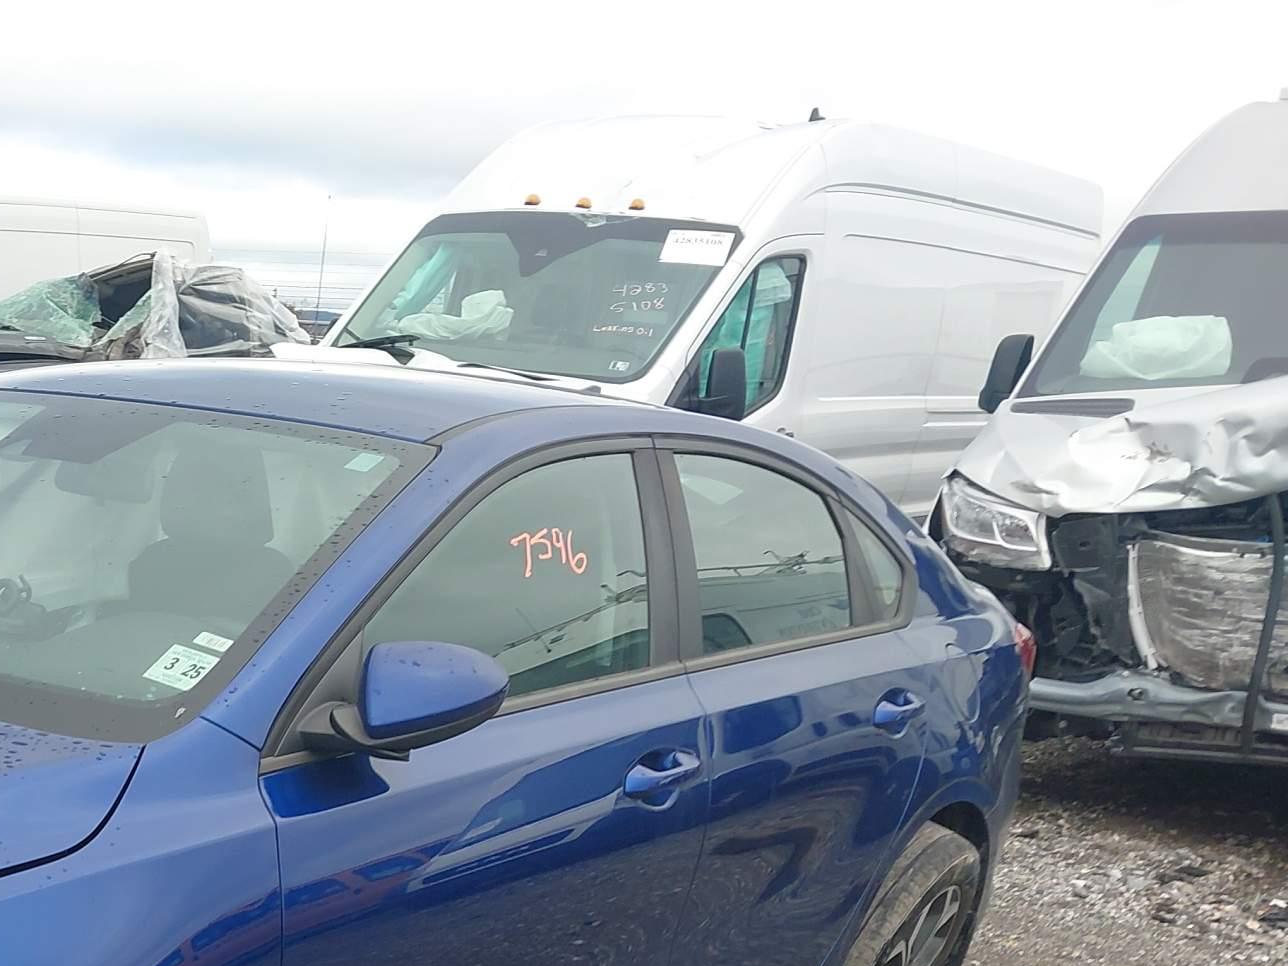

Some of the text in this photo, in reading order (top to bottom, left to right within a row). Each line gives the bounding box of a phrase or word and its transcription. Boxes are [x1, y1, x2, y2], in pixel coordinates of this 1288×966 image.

[612, 282, 668, 296] 4283
[609, 297, 665, 312] 5108
[509, 526, 588, 578] 7596
[163, 657, 206, 679] 3 25
